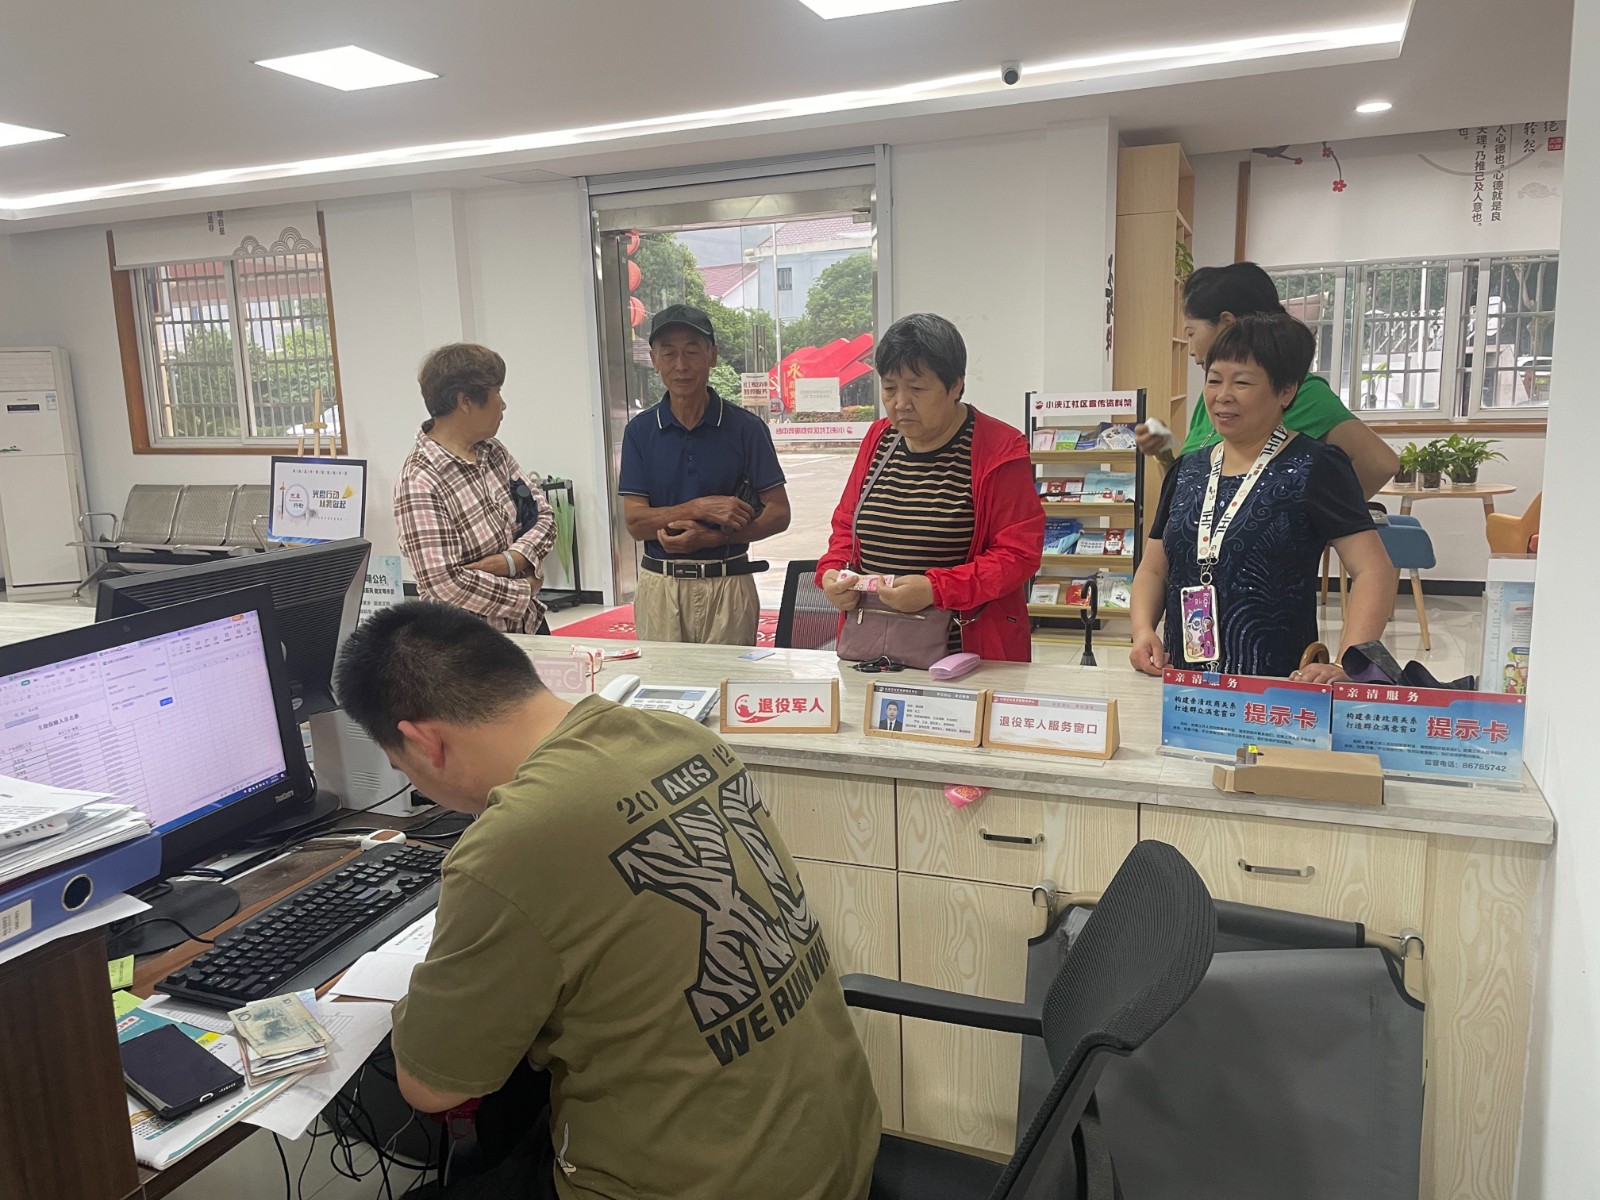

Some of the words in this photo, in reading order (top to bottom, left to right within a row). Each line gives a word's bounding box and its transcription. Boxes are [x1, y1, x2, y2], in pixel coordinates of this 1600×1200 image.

[1045, 398, 1132, 409] 小浃江社区宣传资料架
[1346, 688, 1419, 703] 亲清服务
[758, 697, 825, 713] 退役军人
[999, 715, 1098, 735] 退役军人服务窗口
[1243, 702, 1318, 730] 提示卡
[1346, 712, 1418, 725] 构建亲清政商关系
[1346, 722, 1417, 734] 打造群众满意窗口
[1426, 715, 1511, 743] 提示卡
[616, 789, 659, 825] 20
[661, 759, 713, 801] AHS
[711, 743, 735, 768] 12
[704, 1002, 776, 1067] WE
[769, 959, 814, 1027] RUN
